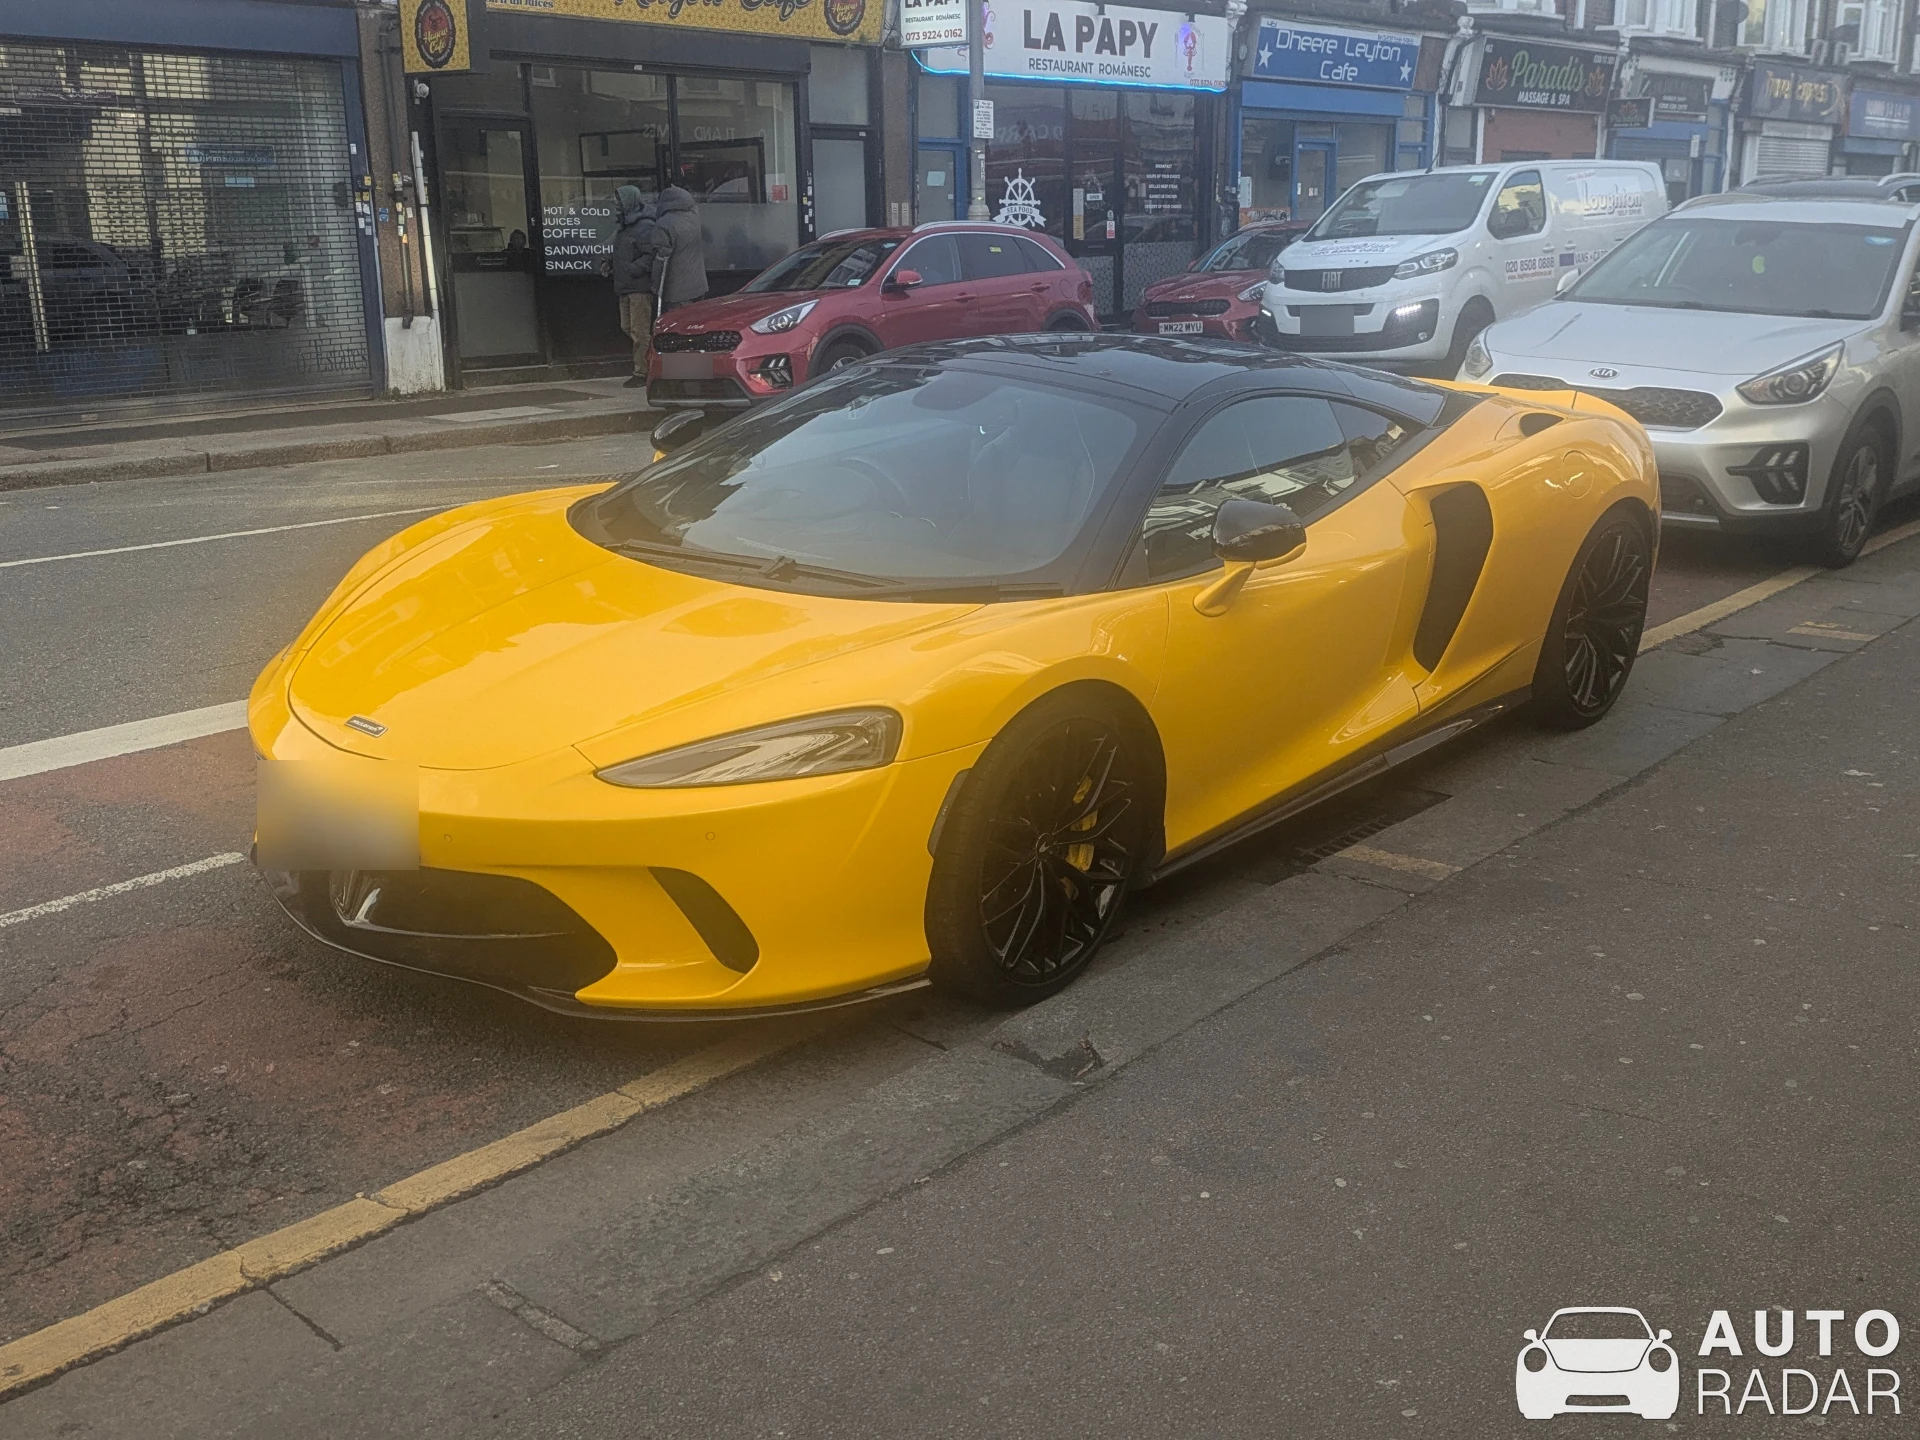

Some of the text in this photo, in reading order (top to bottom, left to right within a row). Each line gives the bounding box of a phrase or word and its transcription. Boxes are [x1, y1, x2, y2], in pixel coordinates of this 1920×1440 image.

[906, 28, 962, 41] 073 9224 0162
[1023, 9, 1159, 58] LA PAPY
[1276, 29, 1338, 54] Dheere
[1344, 37, 1401, 62] Leyton
[1028, 58, 1151, 78] RESTAURANT ROMÂNESC
[1320, 60, 1358, 81] Cafe
[1511, 50, 1586, 92] Paradis
[1517, 91, 1570, 105] MASSAGE & SPA
[1582, 181, 1642, 214] Loughton
[543, 206, 610, 216] HOT & COLD
[1006, 206, 1034, 214] SEA FOOD
[542, 217, 581, 226] JUICES
[542, 228, 597, 239] COFFEE
[545, 260, 592, 270] SNACK
[1505, 257, 1555, 273] 020 8508 0888
[1321, 271, 1342, 290] FIAT
[1592, 369, 1613, 377] KIA
[350, 719, 379, 732] McLaren
